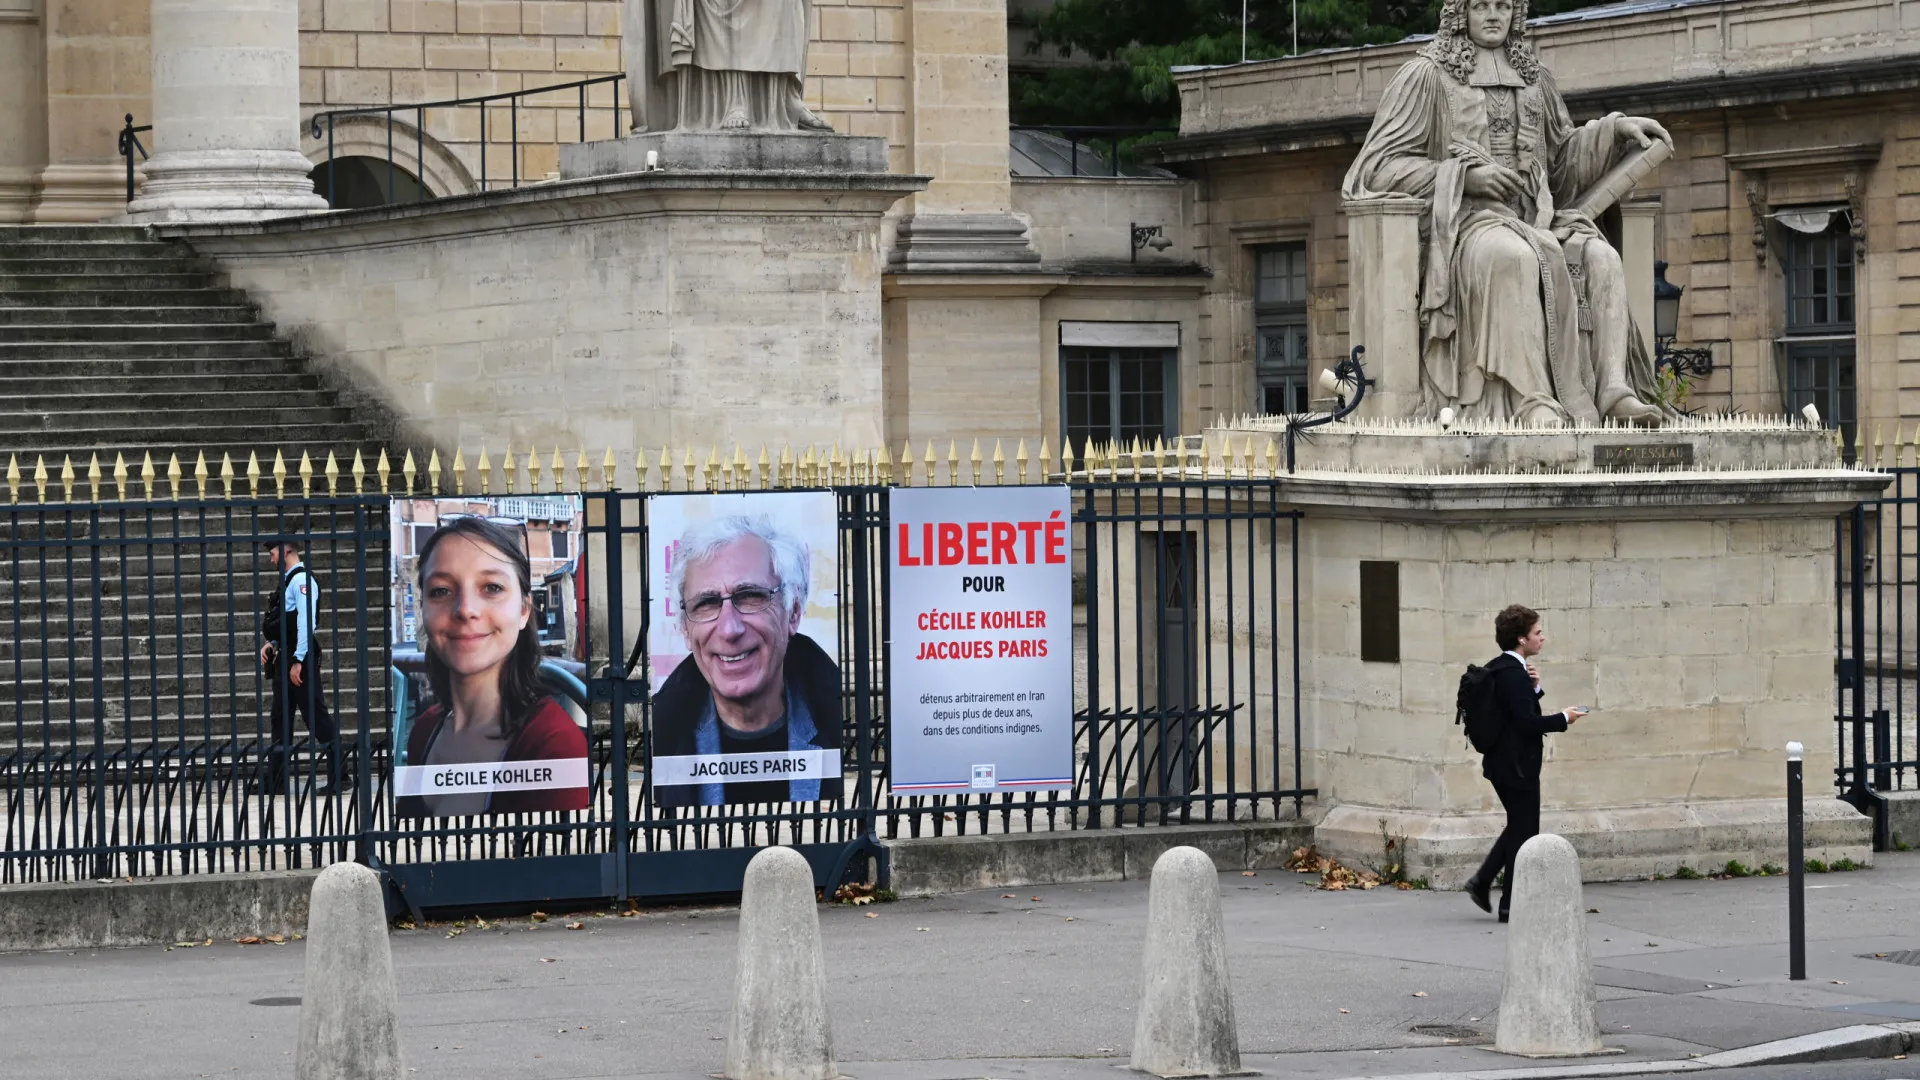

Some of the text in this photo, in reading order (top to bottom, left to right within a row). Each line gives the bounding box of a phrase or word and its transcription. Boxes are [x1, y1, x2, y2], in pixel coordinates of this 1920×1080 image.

[898, 510, 1066, 567] LIBERTÉ
[962, 576, 1005, 593] POUR
[917, 608, 1046, 631] CÉCILE KOHLER
[916, 639, 1048, 660] JACQUES PARIS
[920, 691, 1045, 704] détenus arbitrairement en Iran
[933, 708, 1033, 721] depuis plus de deux ans,
[923, 723, 1043, 736] dans des conditions indignes.
[434, 767, 553, 787] CÉCILE KOHLER
[689, 758, 807, 778] JACQUES PARIS
